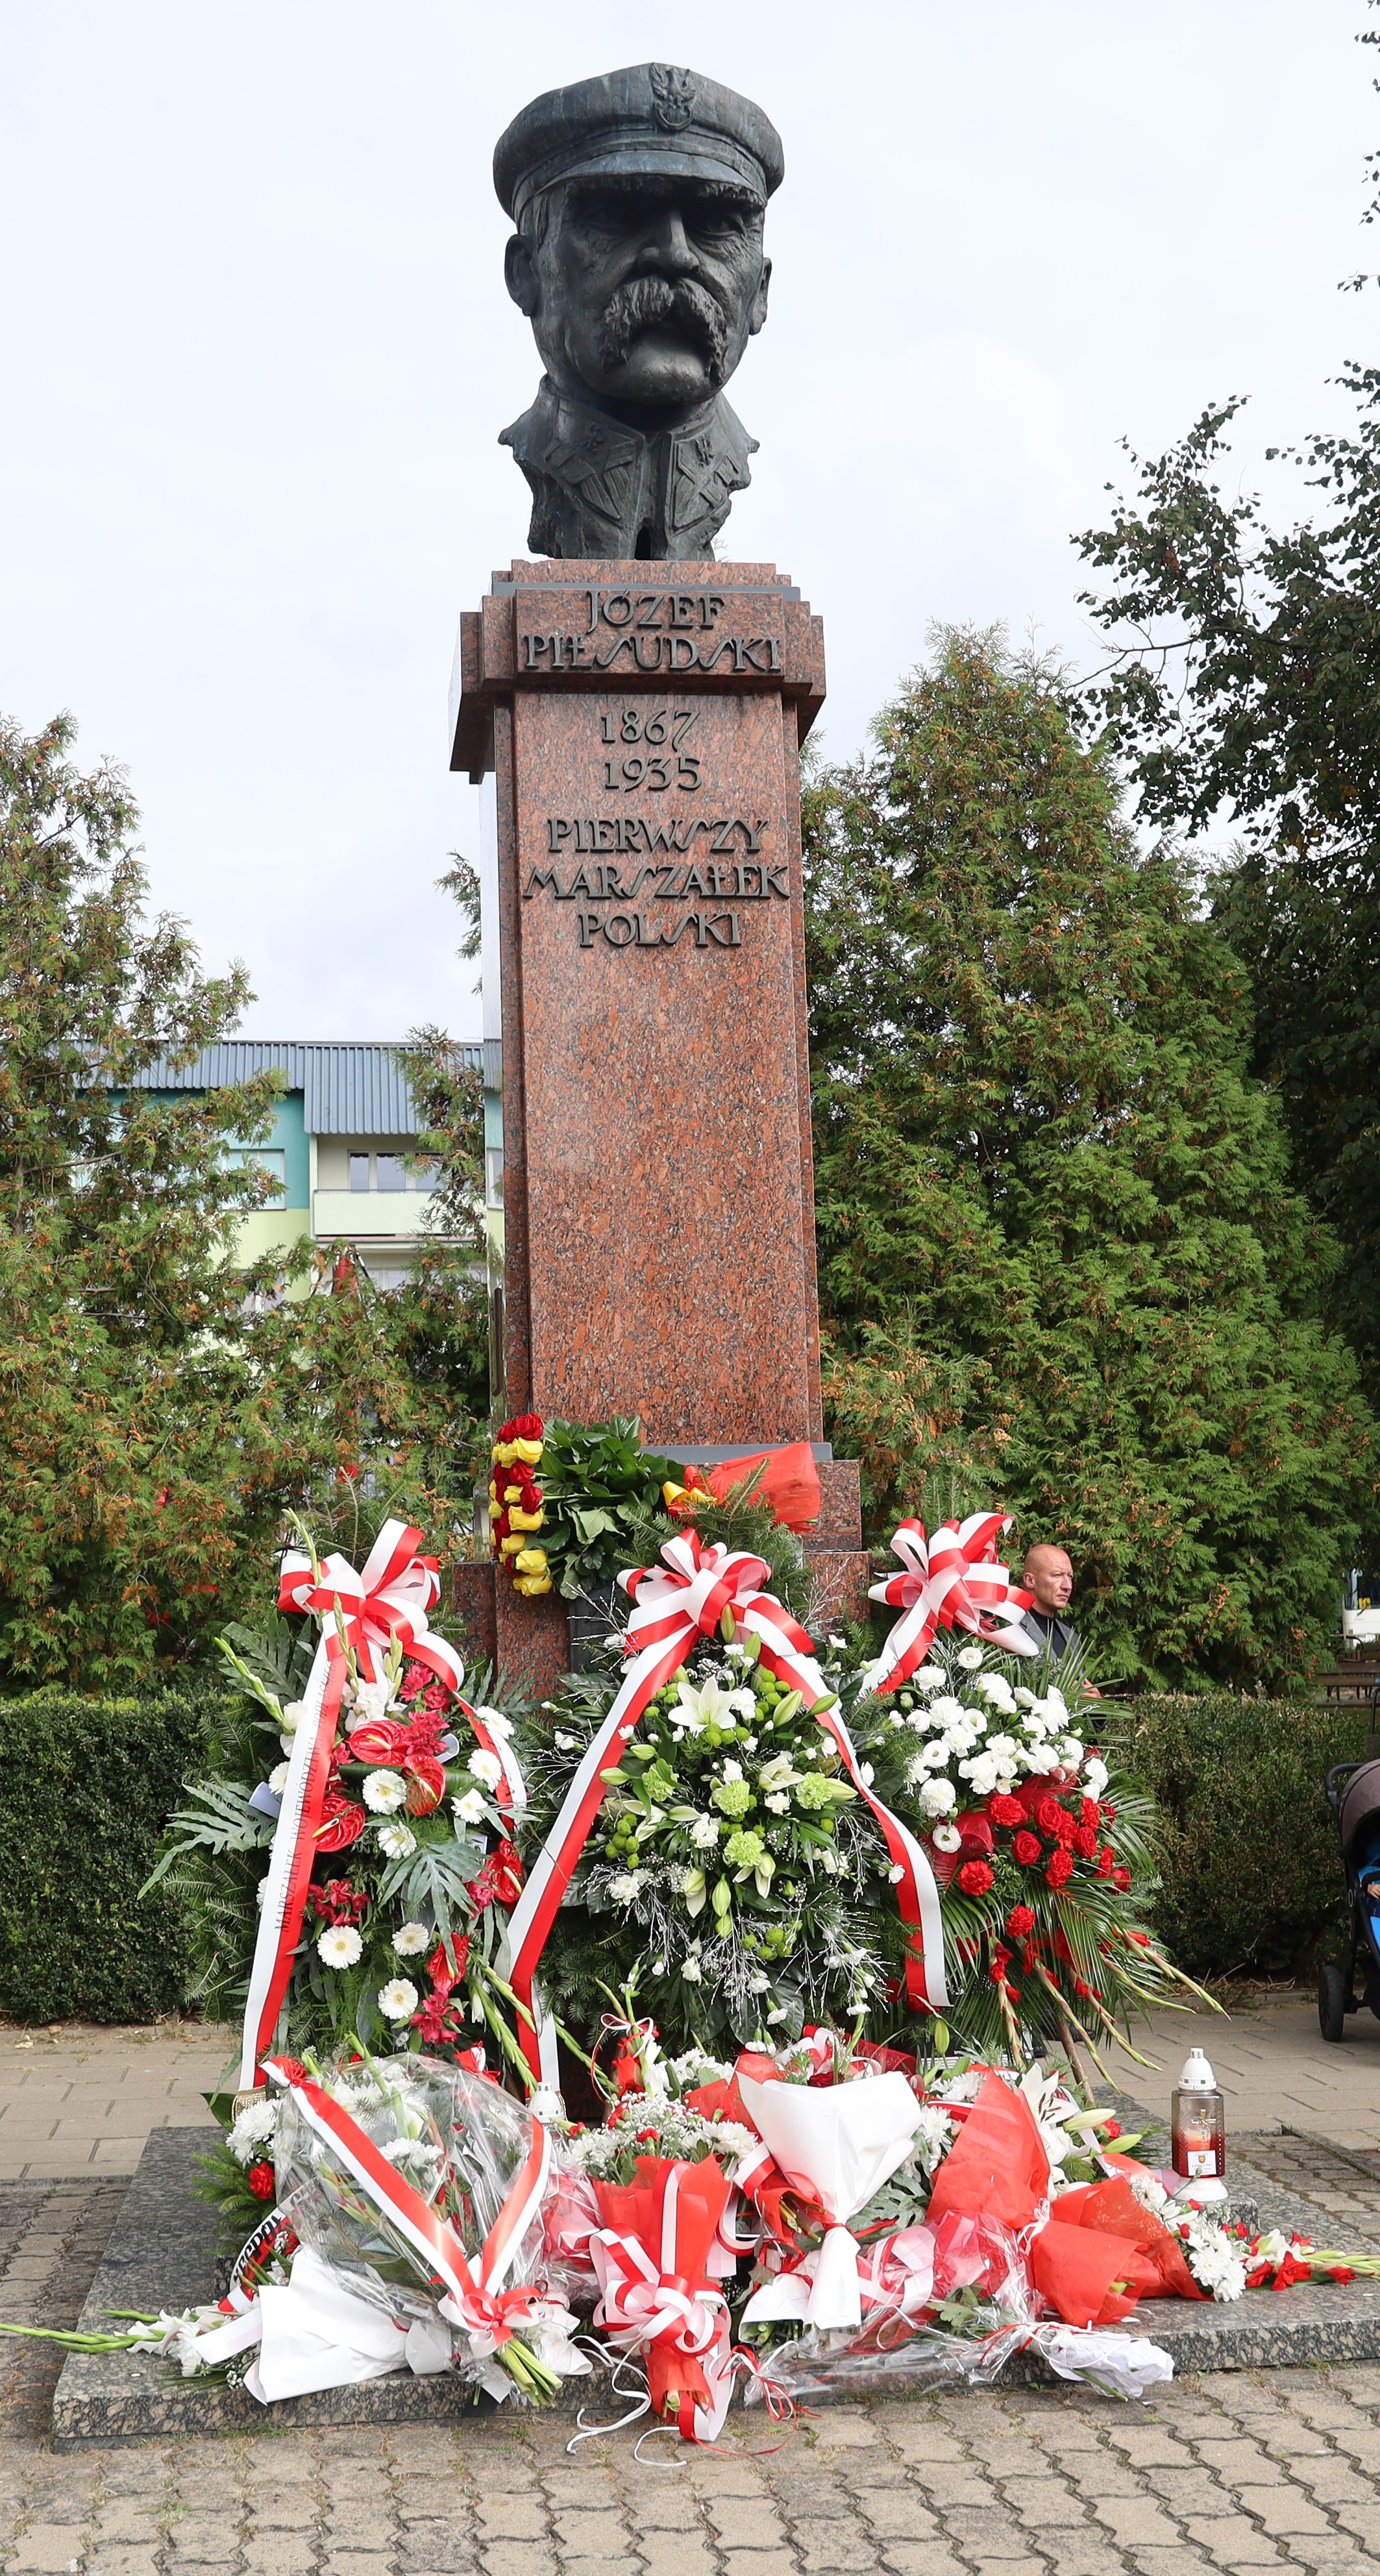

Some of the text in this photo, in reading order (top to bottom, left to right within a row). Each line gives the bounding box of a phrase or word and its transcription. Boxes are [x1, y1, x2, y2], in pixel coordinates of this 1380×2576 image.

[585, 589, 725, 633] JÓZEF
[524, 635, 782, 672] PIŁSUDSKI
[602, 711, 700, 752] 1867
[605, 757, 702, 792] 1935
[548, 819, 768, 853] PIERWSZY
[523, 865, 791, 899] MARSZAŁEK
[578, 913, 742, 946] POLSKI
[290, 1737, 324, 1841] WOJEWÓDZTWA
